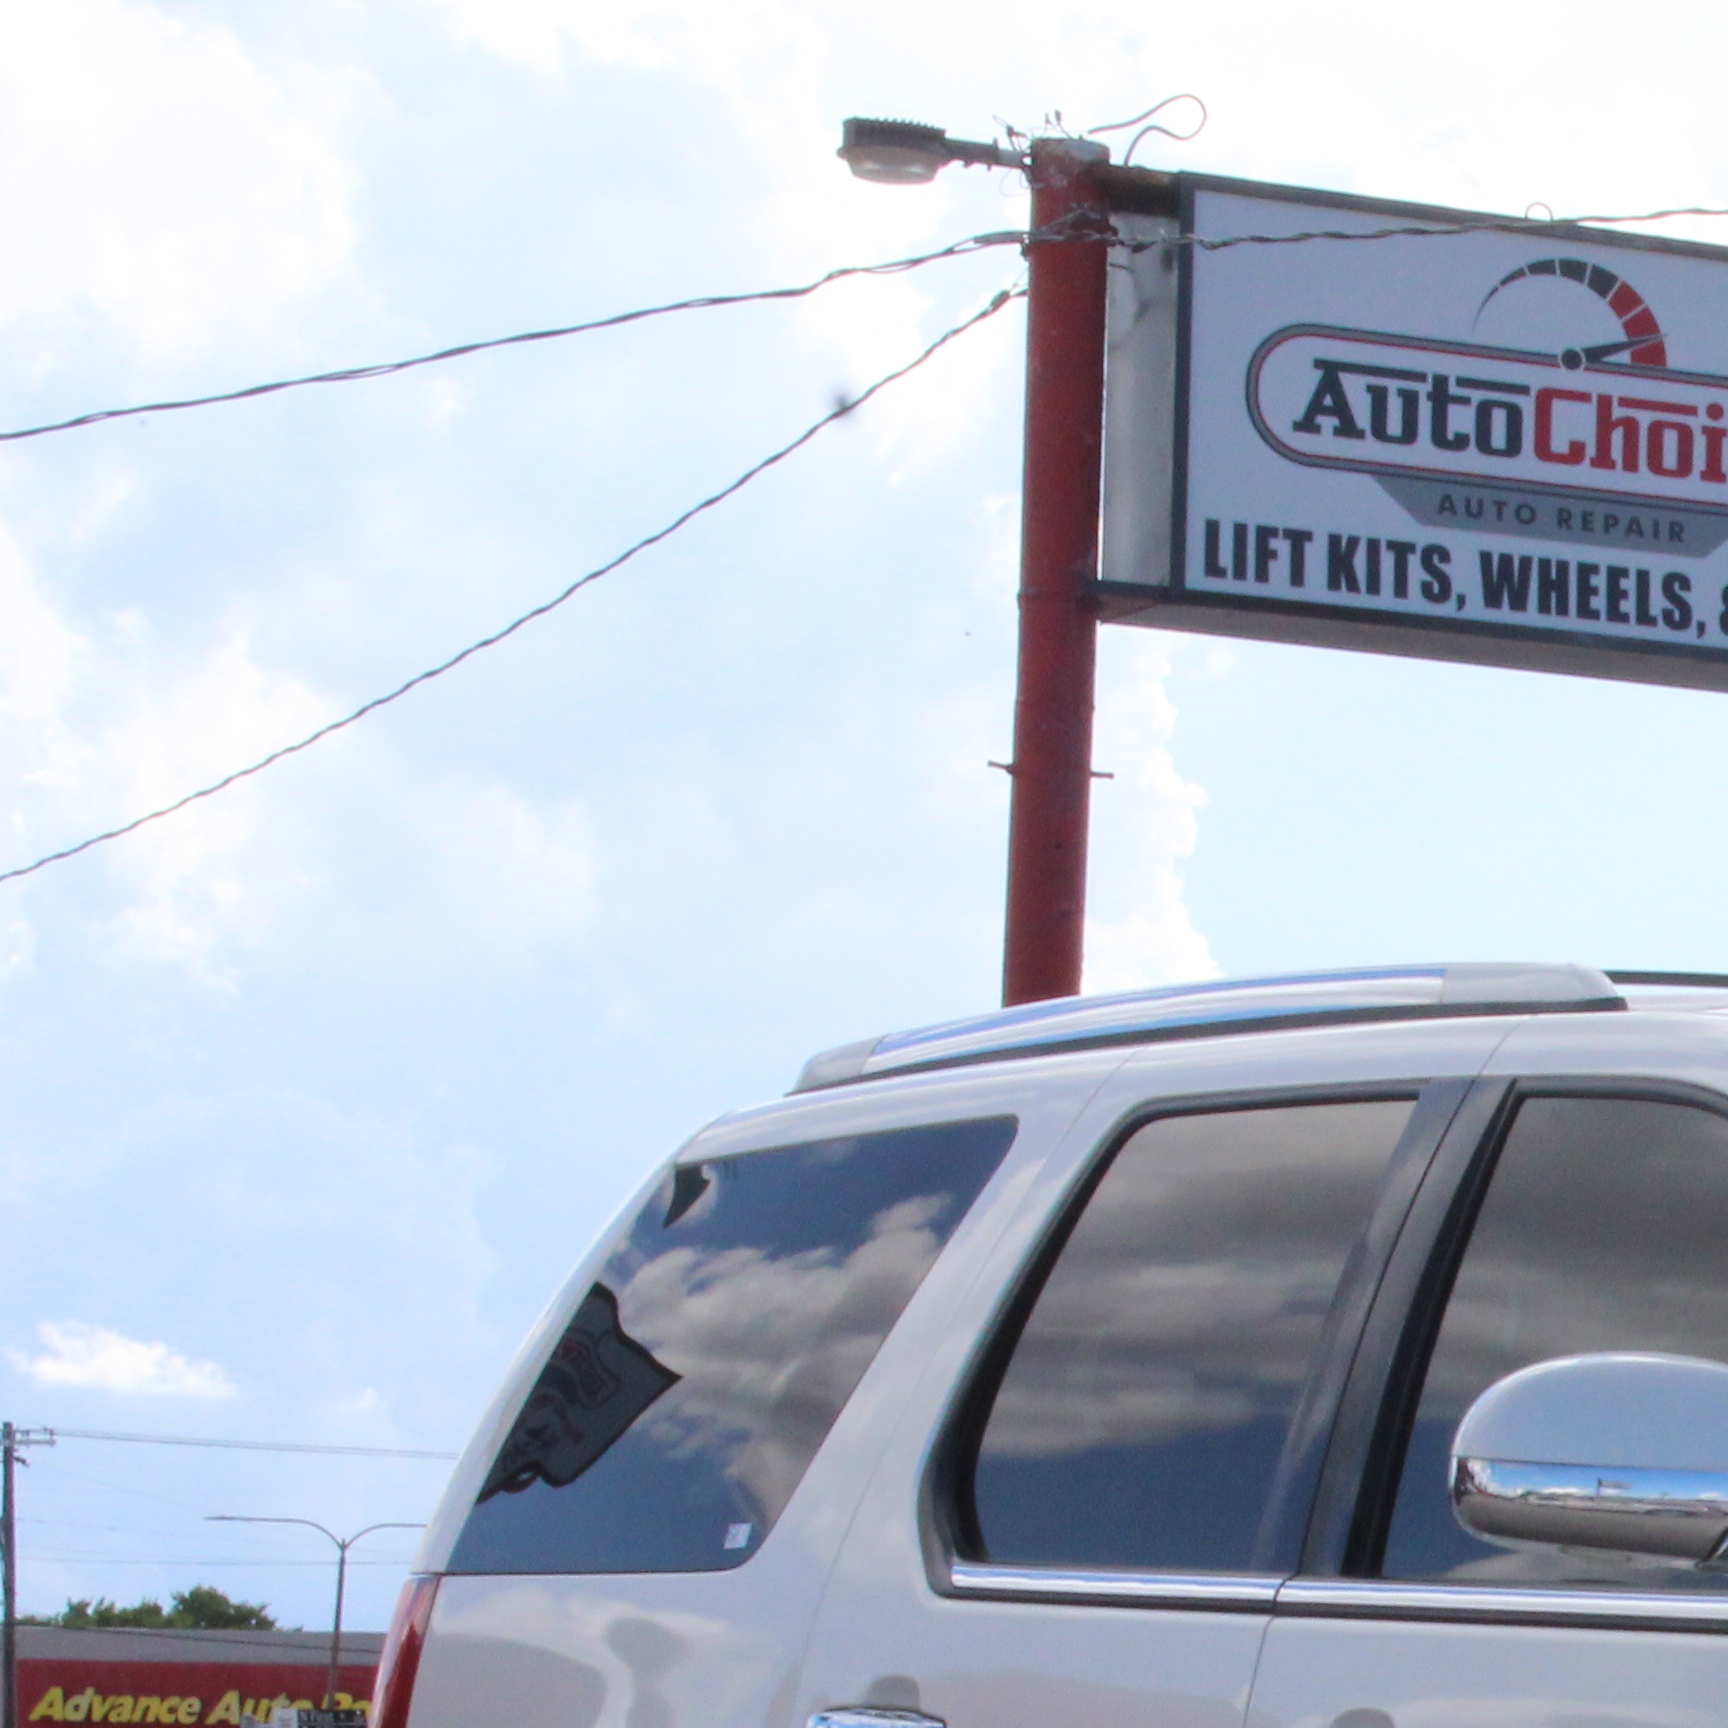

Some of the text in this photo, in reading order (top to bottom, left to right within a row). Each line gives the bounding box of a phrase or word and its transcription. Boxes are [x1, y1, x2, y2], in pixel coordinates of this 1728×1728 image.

[1437, 494, 1687, 543] AUTO REPAIR
[1203, 518, 1313, 588] LIFT
[1326, 533, 1466, 613] KITS,
[1478, 549, 1706, 640] WHEELS,
[28, 1686, 201, 1725] Advance
